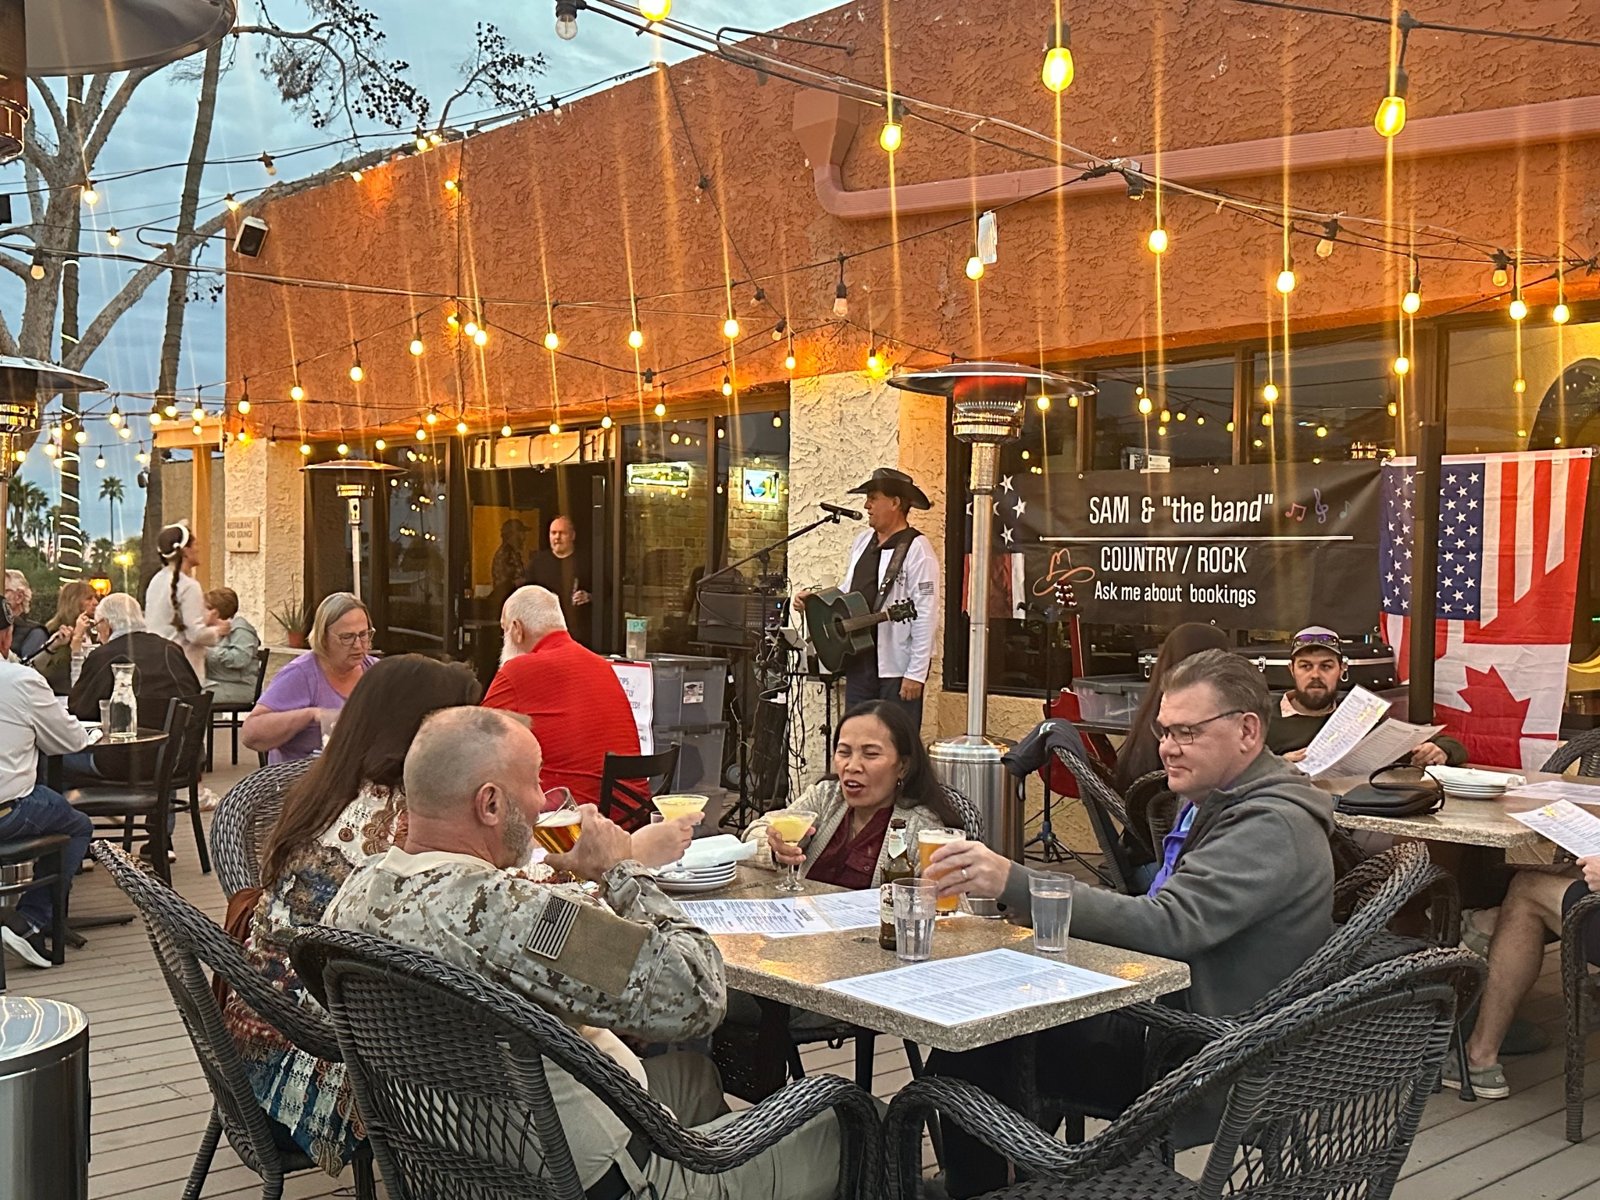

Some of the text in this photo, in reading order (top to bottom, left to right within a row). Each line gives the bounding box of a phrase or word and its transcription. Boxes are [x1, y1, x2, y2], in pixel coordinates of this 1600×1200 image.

[1089, 493, 1274, 524] SAM & "the band"
[1101, 545, 1248, 574] COUNTRY / ROCK
[1094, 580, 1257, 608] Ask me about bookings
